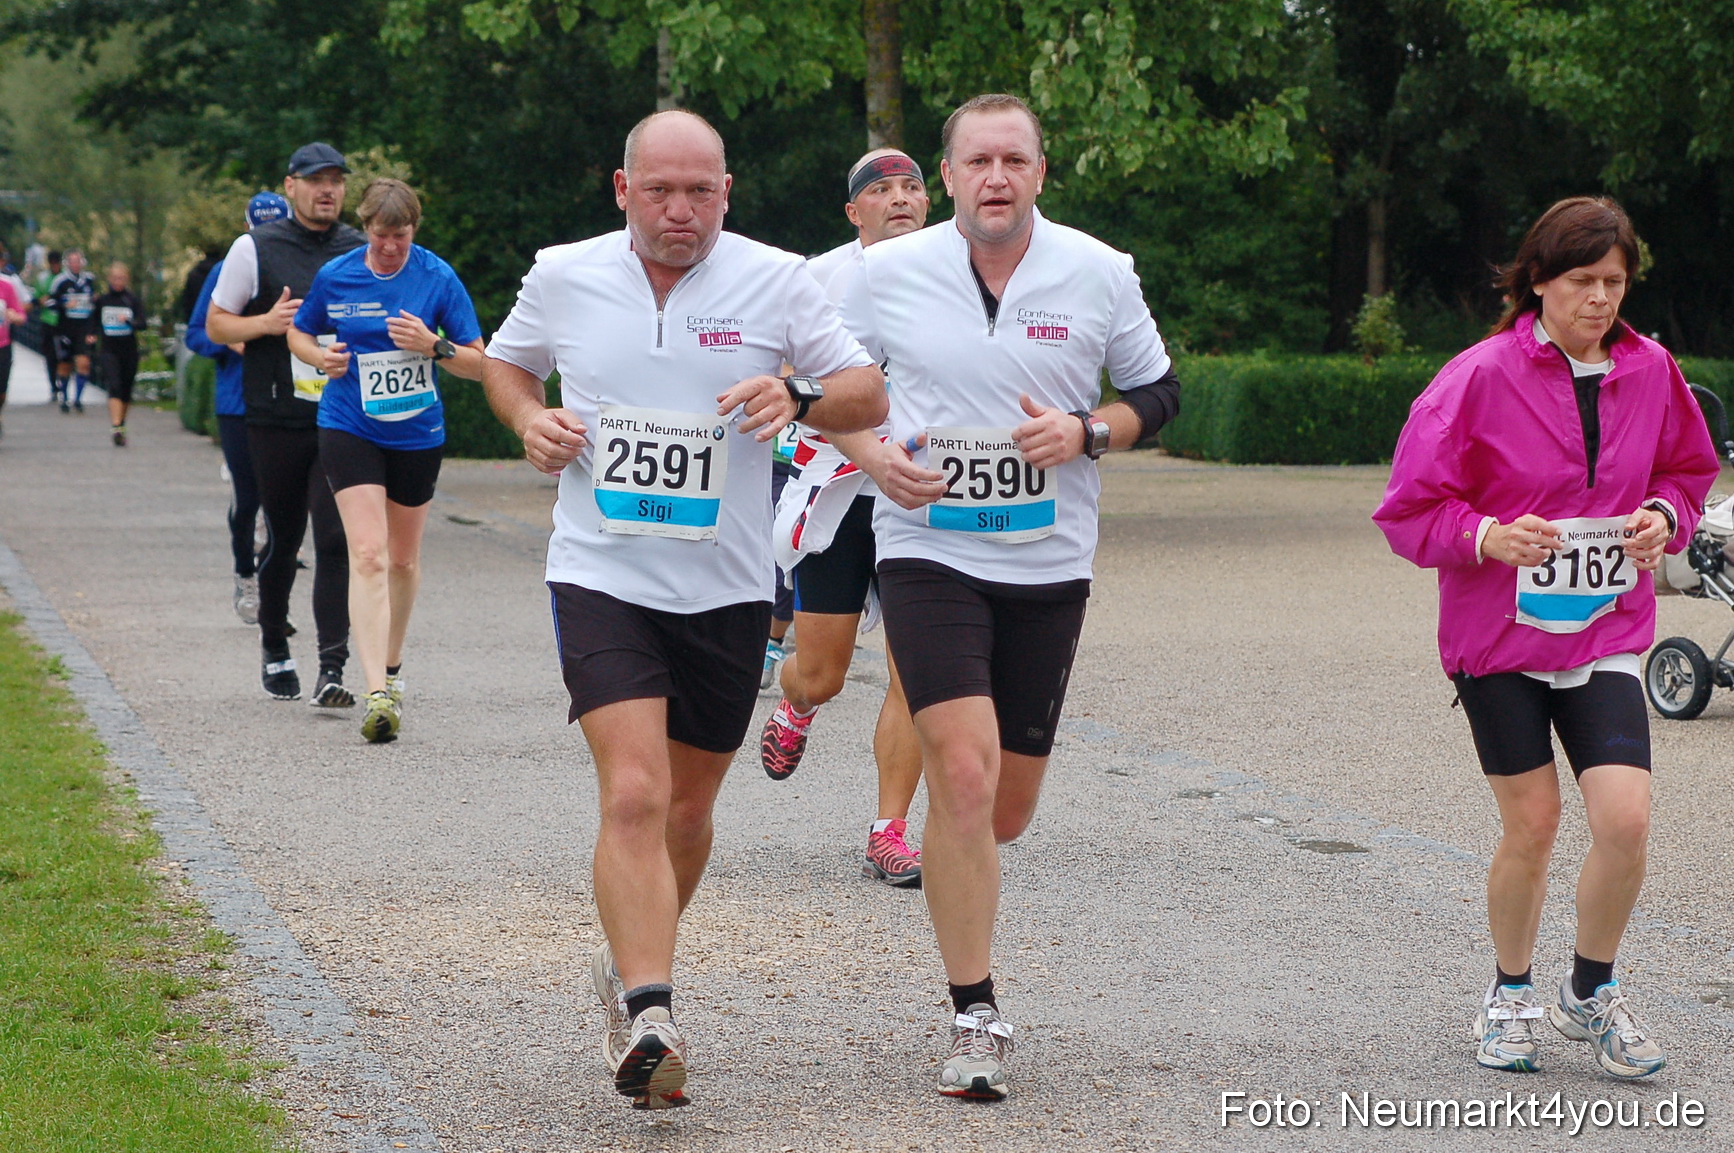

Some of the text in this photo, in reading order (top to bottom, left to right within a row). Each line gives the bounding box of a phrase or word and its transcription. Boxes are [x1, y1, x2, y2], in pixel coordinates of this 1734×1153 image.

[686, 316, 744, 326] Confiserie
[1016, 316, 1059, 328] Service
[1017, 308, 1073, 322] Confiserie
[686, 324, 730, 333] Service
[1027, 327, 1067, 339] Julia
[699, 333, 741, 346] Julia
[360, 356, 420, 368] PARTL Neumarkt
[368, 364, 427, 396] 2624
[377, 397, 424, 413] Hildegard
[600, 417, 709, 439] PARTL Neumarkt
[930, 438, 1018, 451] PARTL Neuma
[603, 437, 713, 492] 2591
[941, 456, 1046, 500] 2590
[637, 499, 673, 522] Sigi
[977, 511, 1010, 531] Sigi
[1567, 528, 1619, 541] Neumarkt
[1531, 544, 1627, 589] 3162
